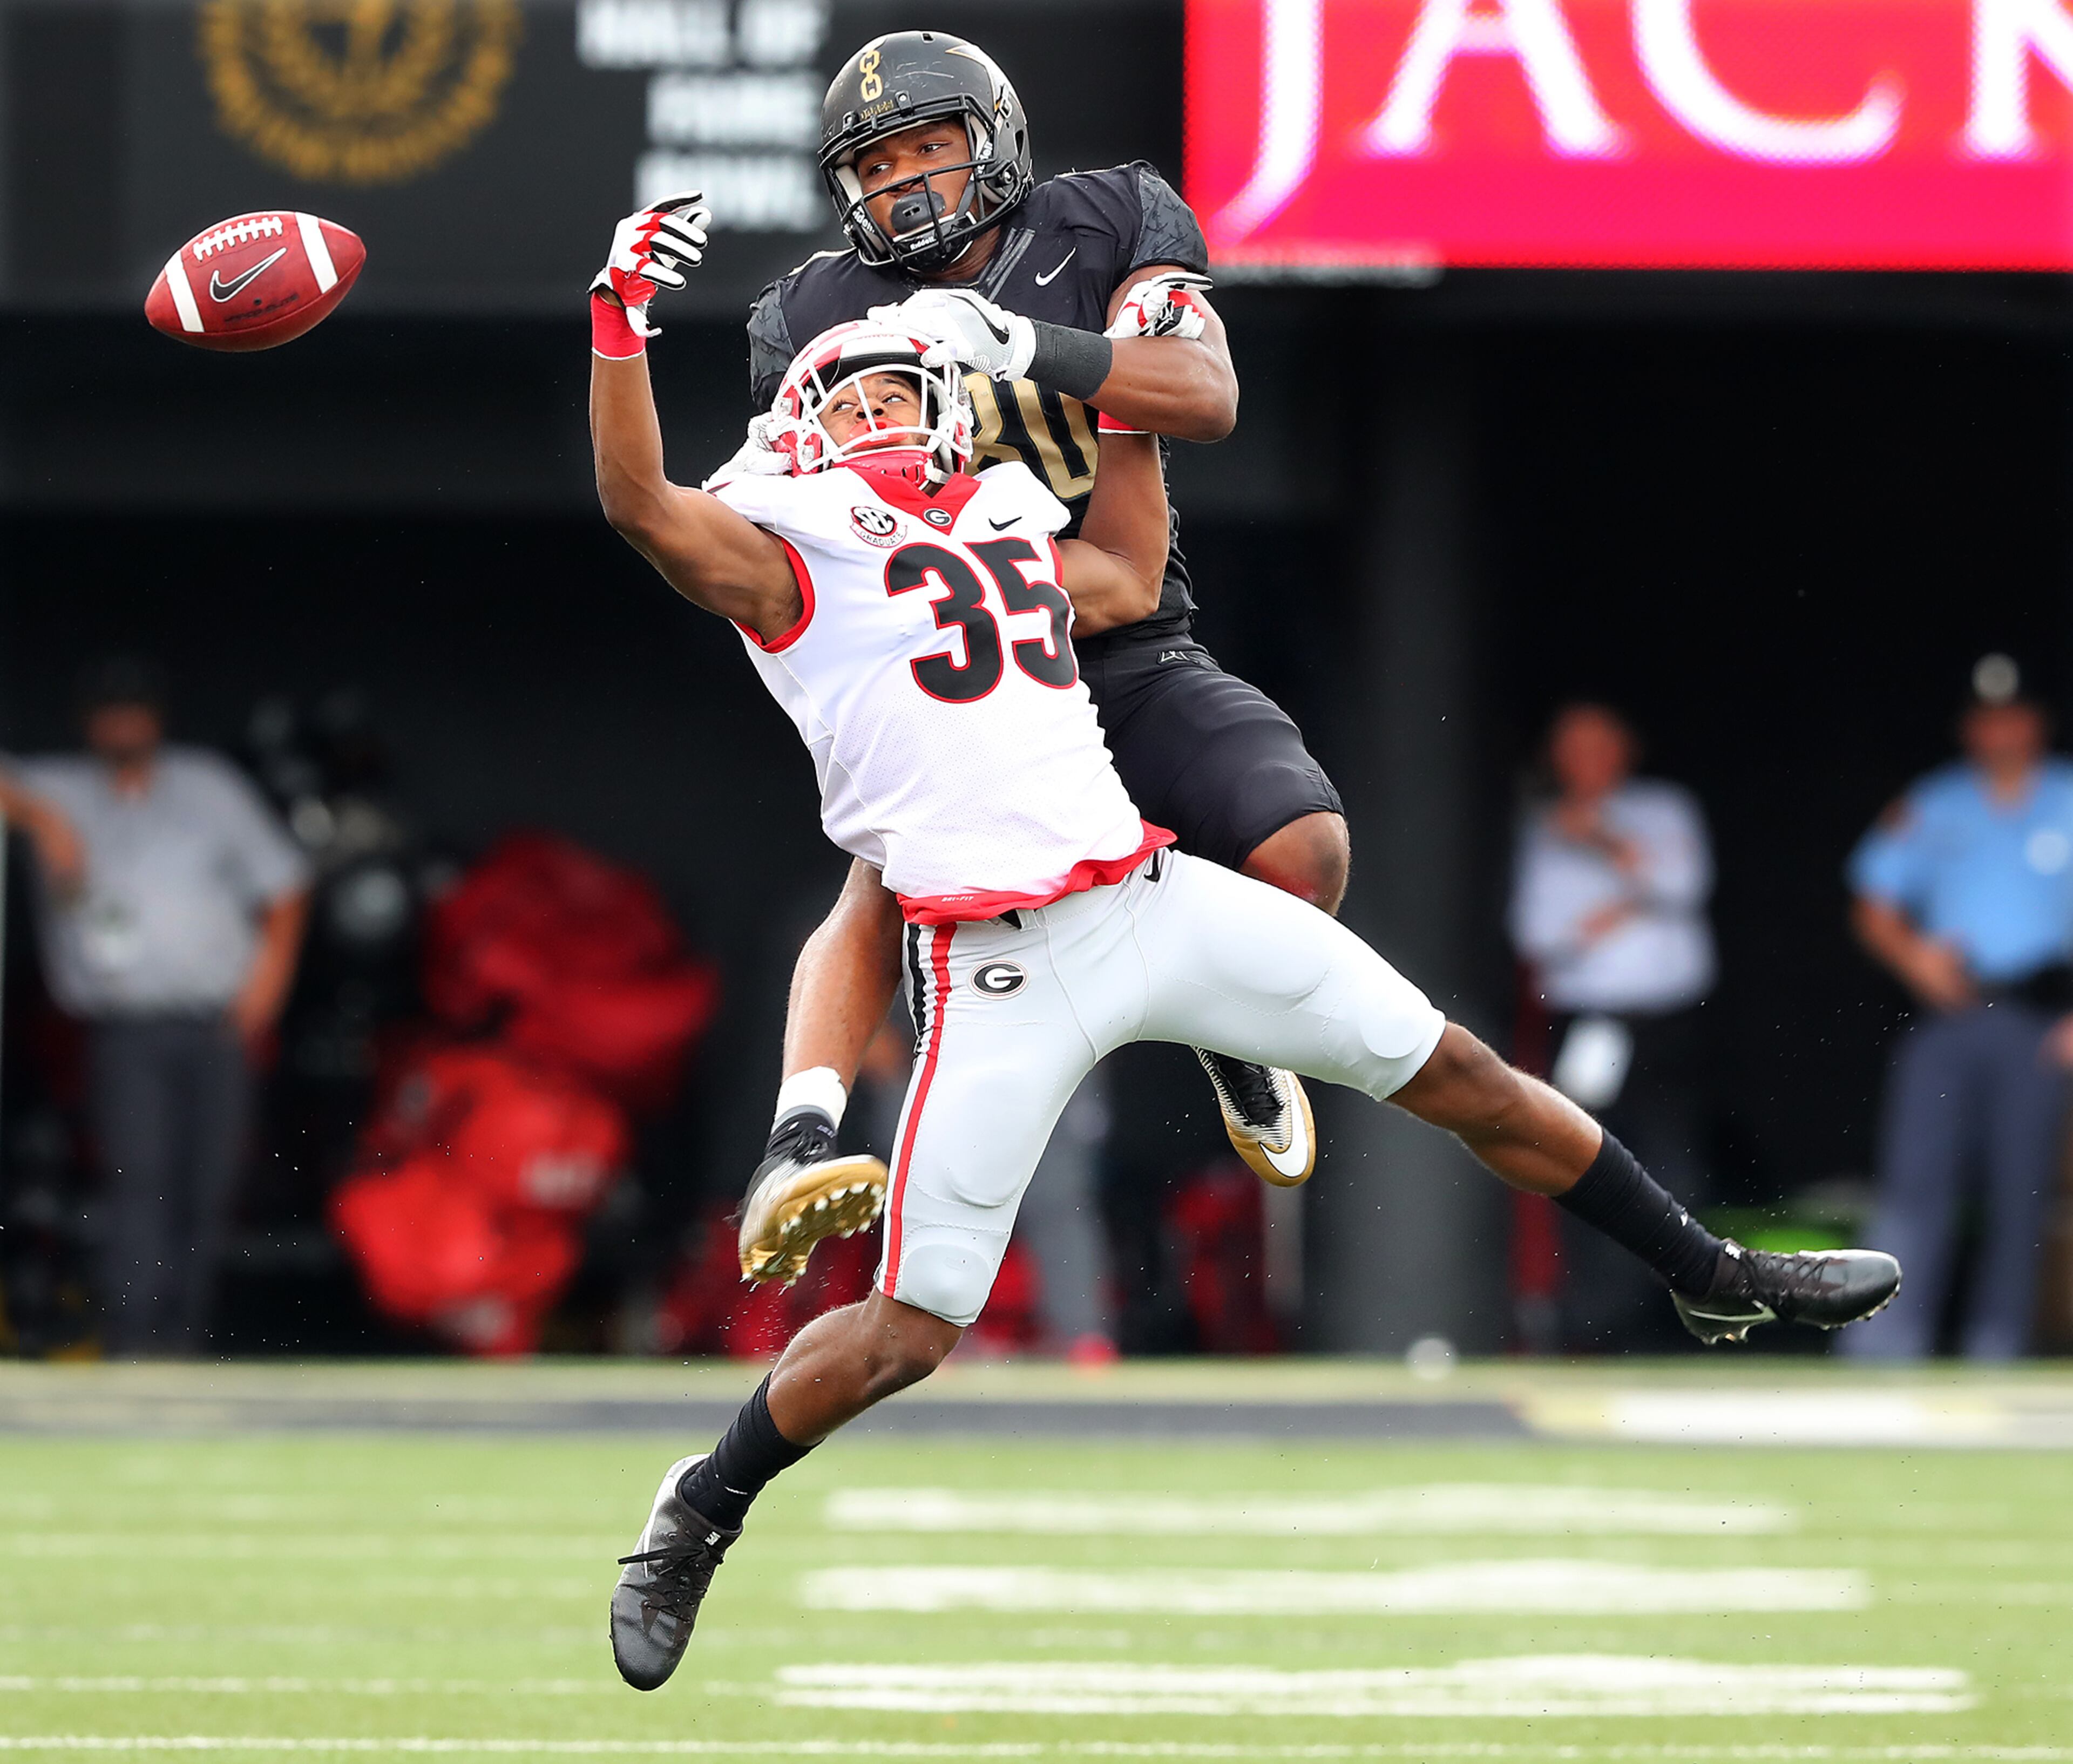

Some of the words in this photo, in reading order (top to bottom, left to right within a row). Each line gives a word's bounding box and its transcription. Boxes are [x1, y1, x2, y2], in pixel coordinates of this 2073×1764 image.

[853, 506, 895, 534] SEC
[925, 509, 951, 525] G
[884, 537, 1077, 703] 35
[973, 964, 1024, 994] G
